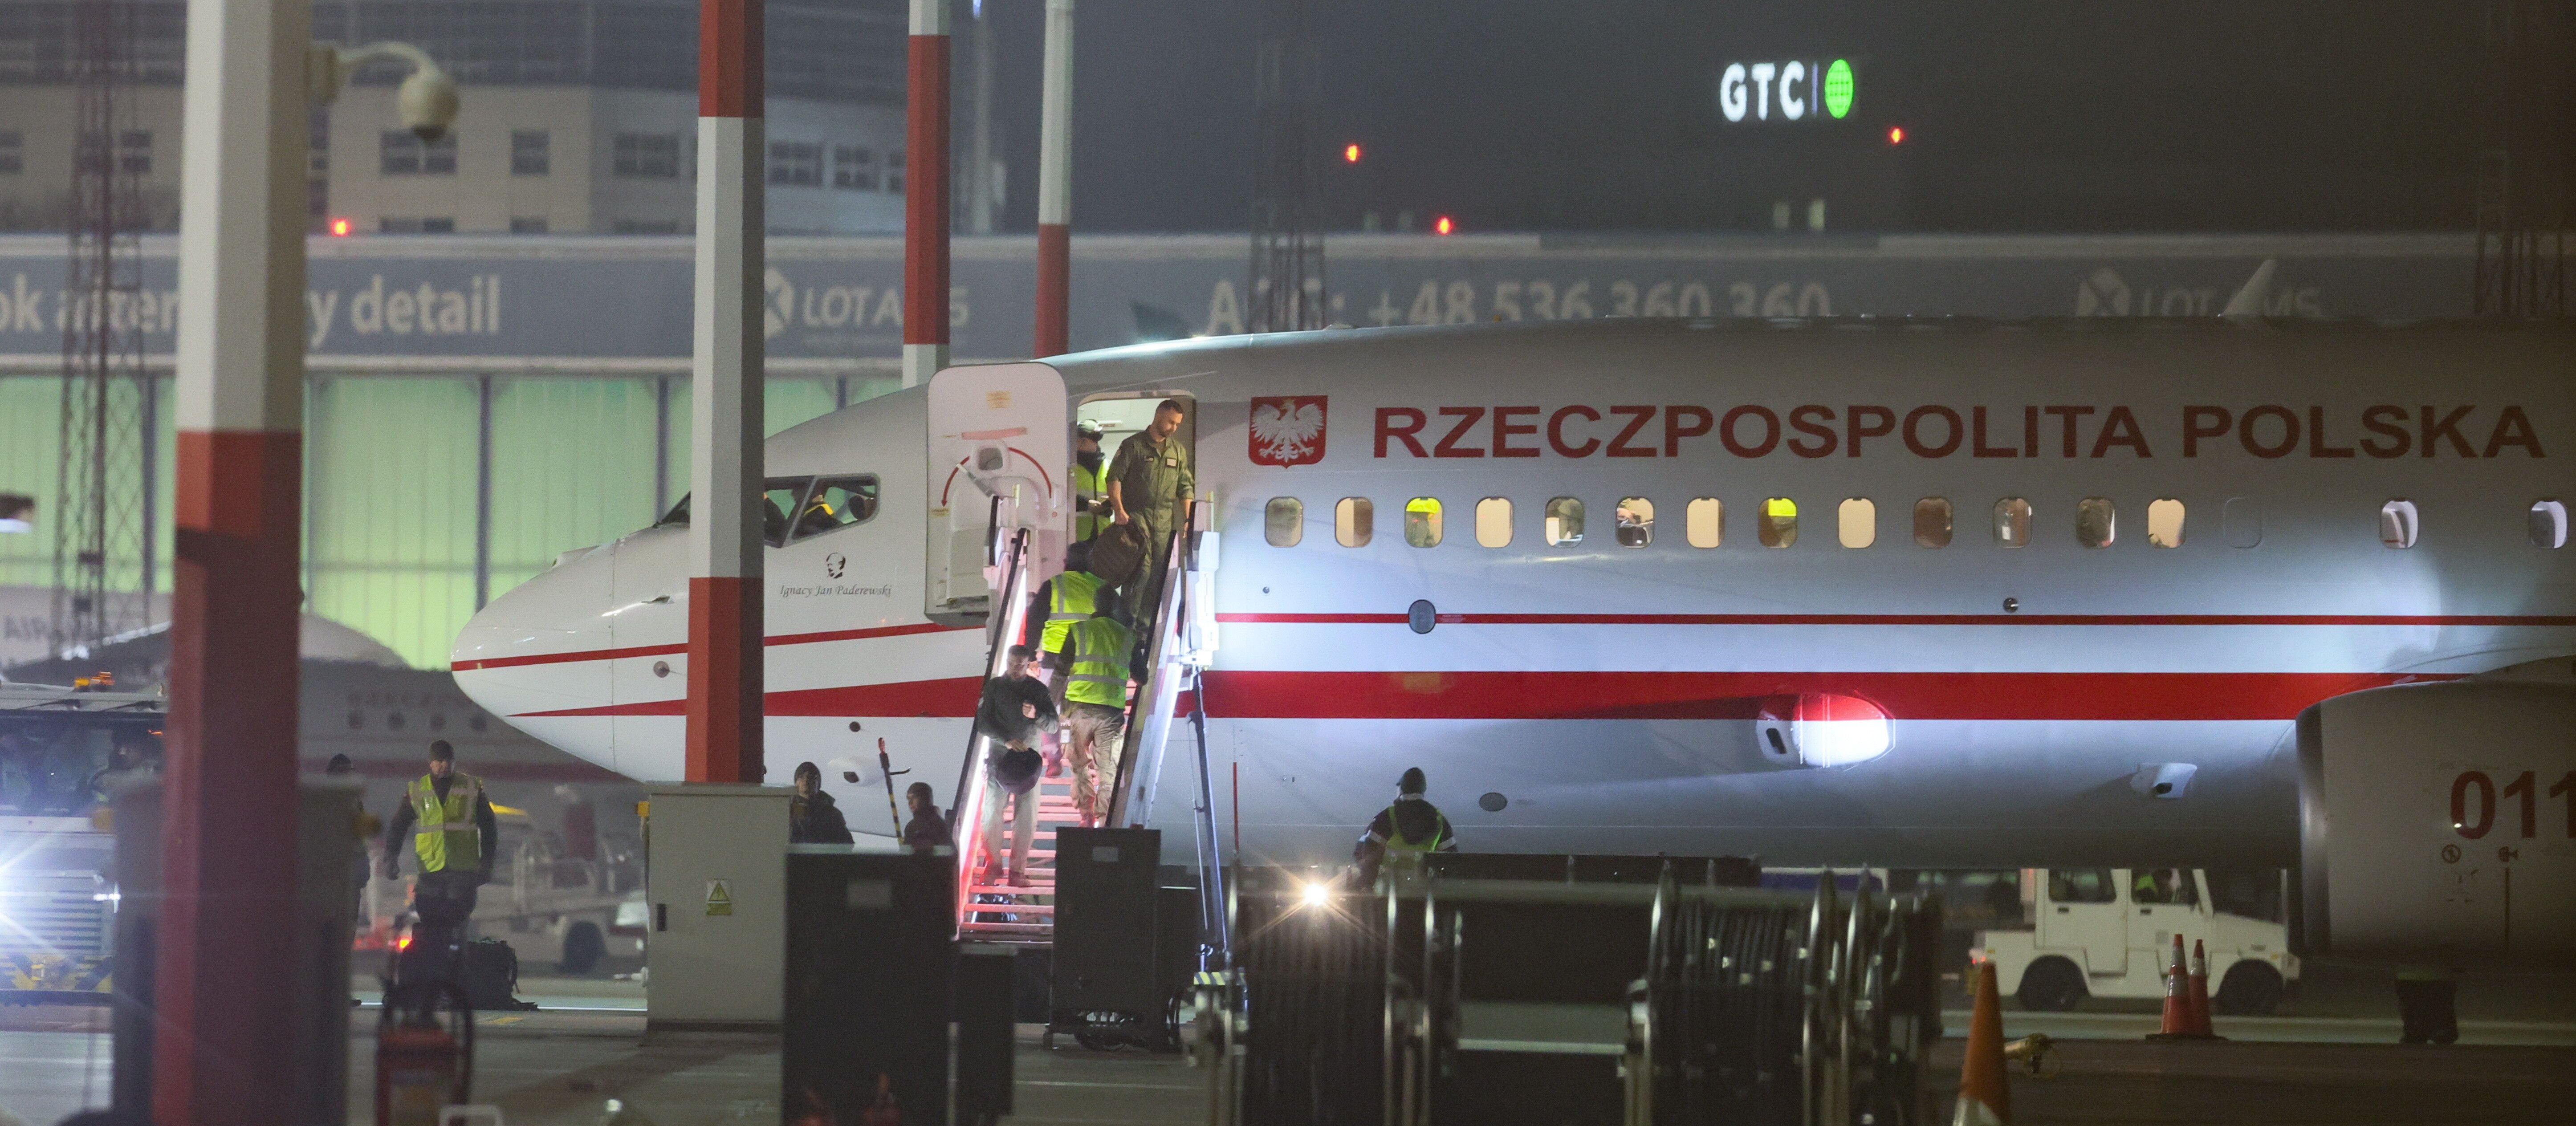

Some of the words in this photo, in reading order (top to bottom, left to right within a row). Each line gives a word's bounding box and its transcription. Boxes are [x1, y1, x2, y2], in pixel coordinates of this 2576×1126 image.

[1720, 61, 1805, 122] GTC
[351, 273, 500, 334] detail
[803, 286, 873, 327] LOT
[870, 287, 969, 327] AS
[1368, 281, 1476, 326] +48
[1493, 280, 1594, 321] 536
[1609, 280, 1713, 317] 360
[1730, 281, 1831, 317] 360
[1373, 404, 2153, 459] RZECZPOSPOLITA
[2183, 404, 2546, 459] POLSKA
[780, 585, 812, 598] Ignacy
[815, 585, 832, 596] Jan
[835, 584, 892, 597] Paderewski
[2450, 770, 2576, 840] 011
